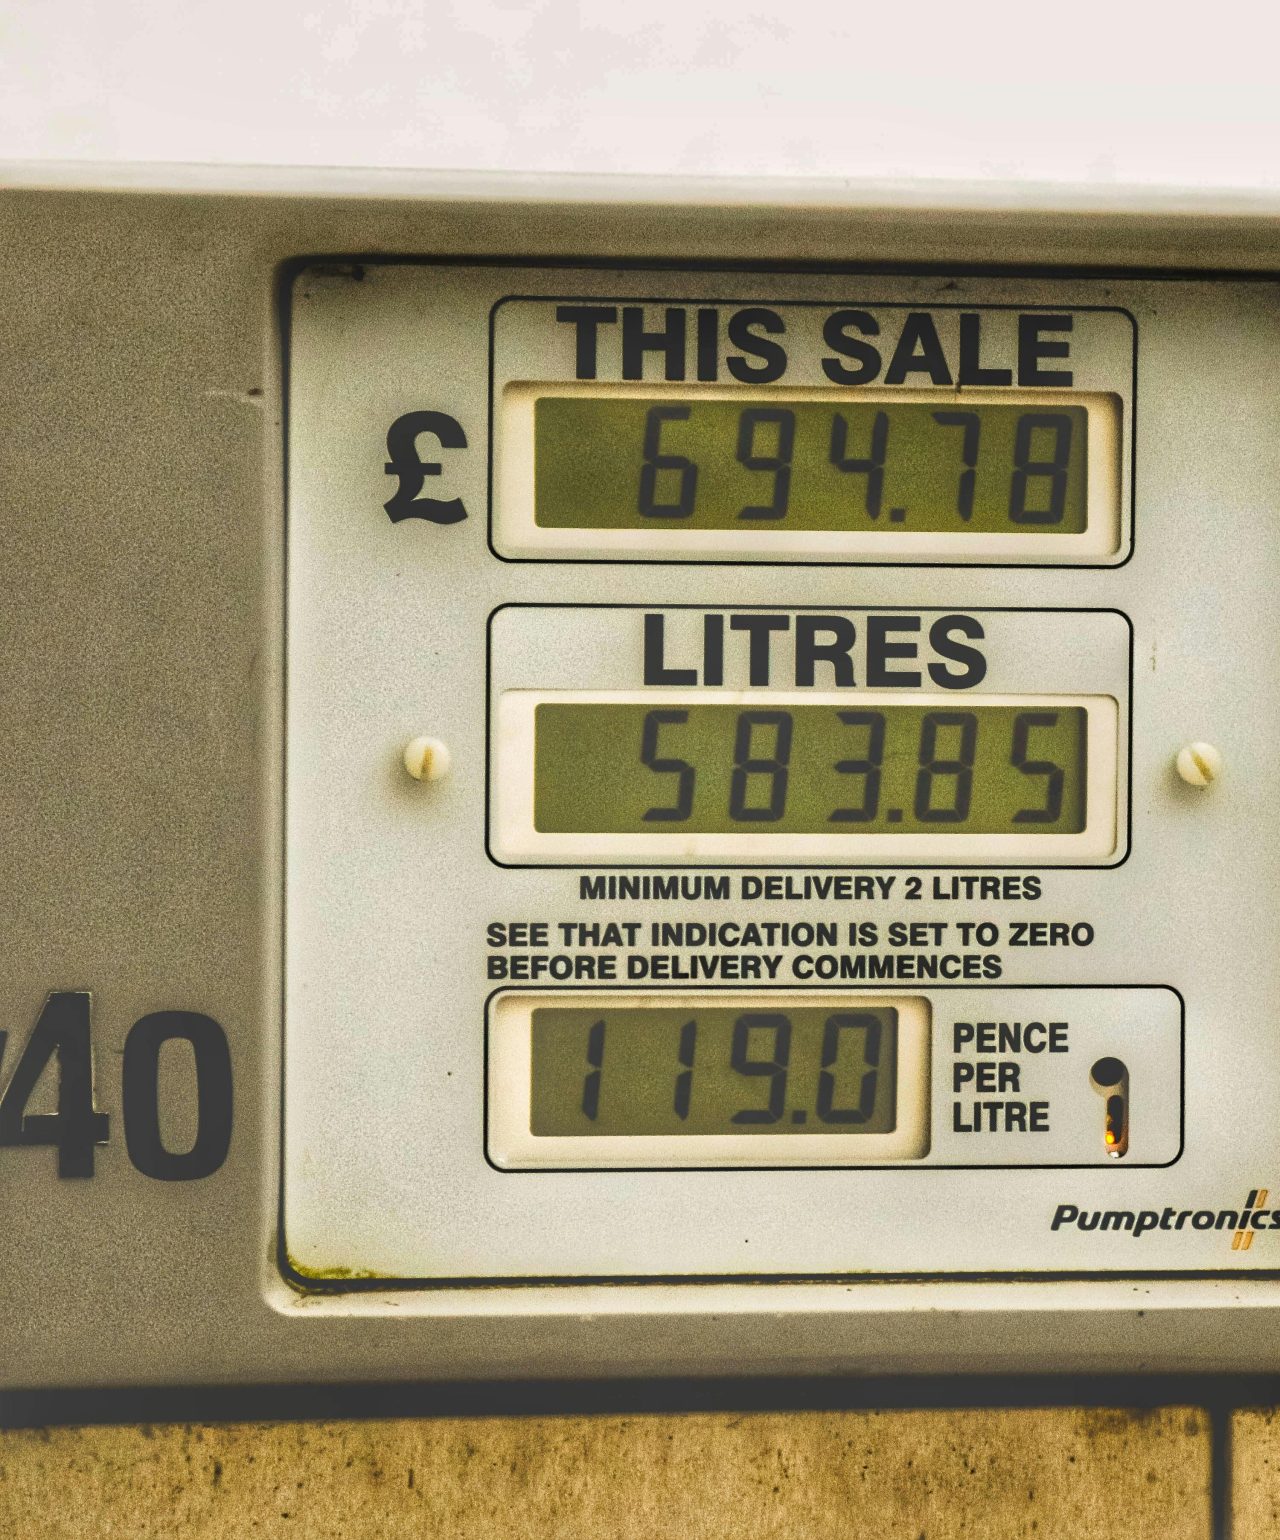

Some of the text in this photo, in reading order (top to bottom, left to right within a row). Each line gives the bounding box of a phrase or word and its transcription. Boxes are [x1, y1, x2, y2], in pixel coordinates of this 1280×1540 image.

[556, 306, 1074, 388] THIS SALE
[383, 410, 469, 526] £
[637, 406, 1073, 525] 694.78
[643, 613, 988, 688] LITRES
[640, 710, 1066, 824] 583.85
[580, 875, 1042, 901] MINIMUM DELIVERY 2 LITRES
[486, 922, 1095, 948] SEE THAT INDICATION IS SET TO ZERO
[487, 954, 1002, 980] BEFORE DELIVERY COMMENCES
[579, 1012, 883, 1126] 119.0
[953, 1022, 1069, 1054] PENCE
[0, 991, 234, 1182] 40
[953, 1062, 1021, 1093] PER
[953, 1101, 1050, 1133] LITRE
